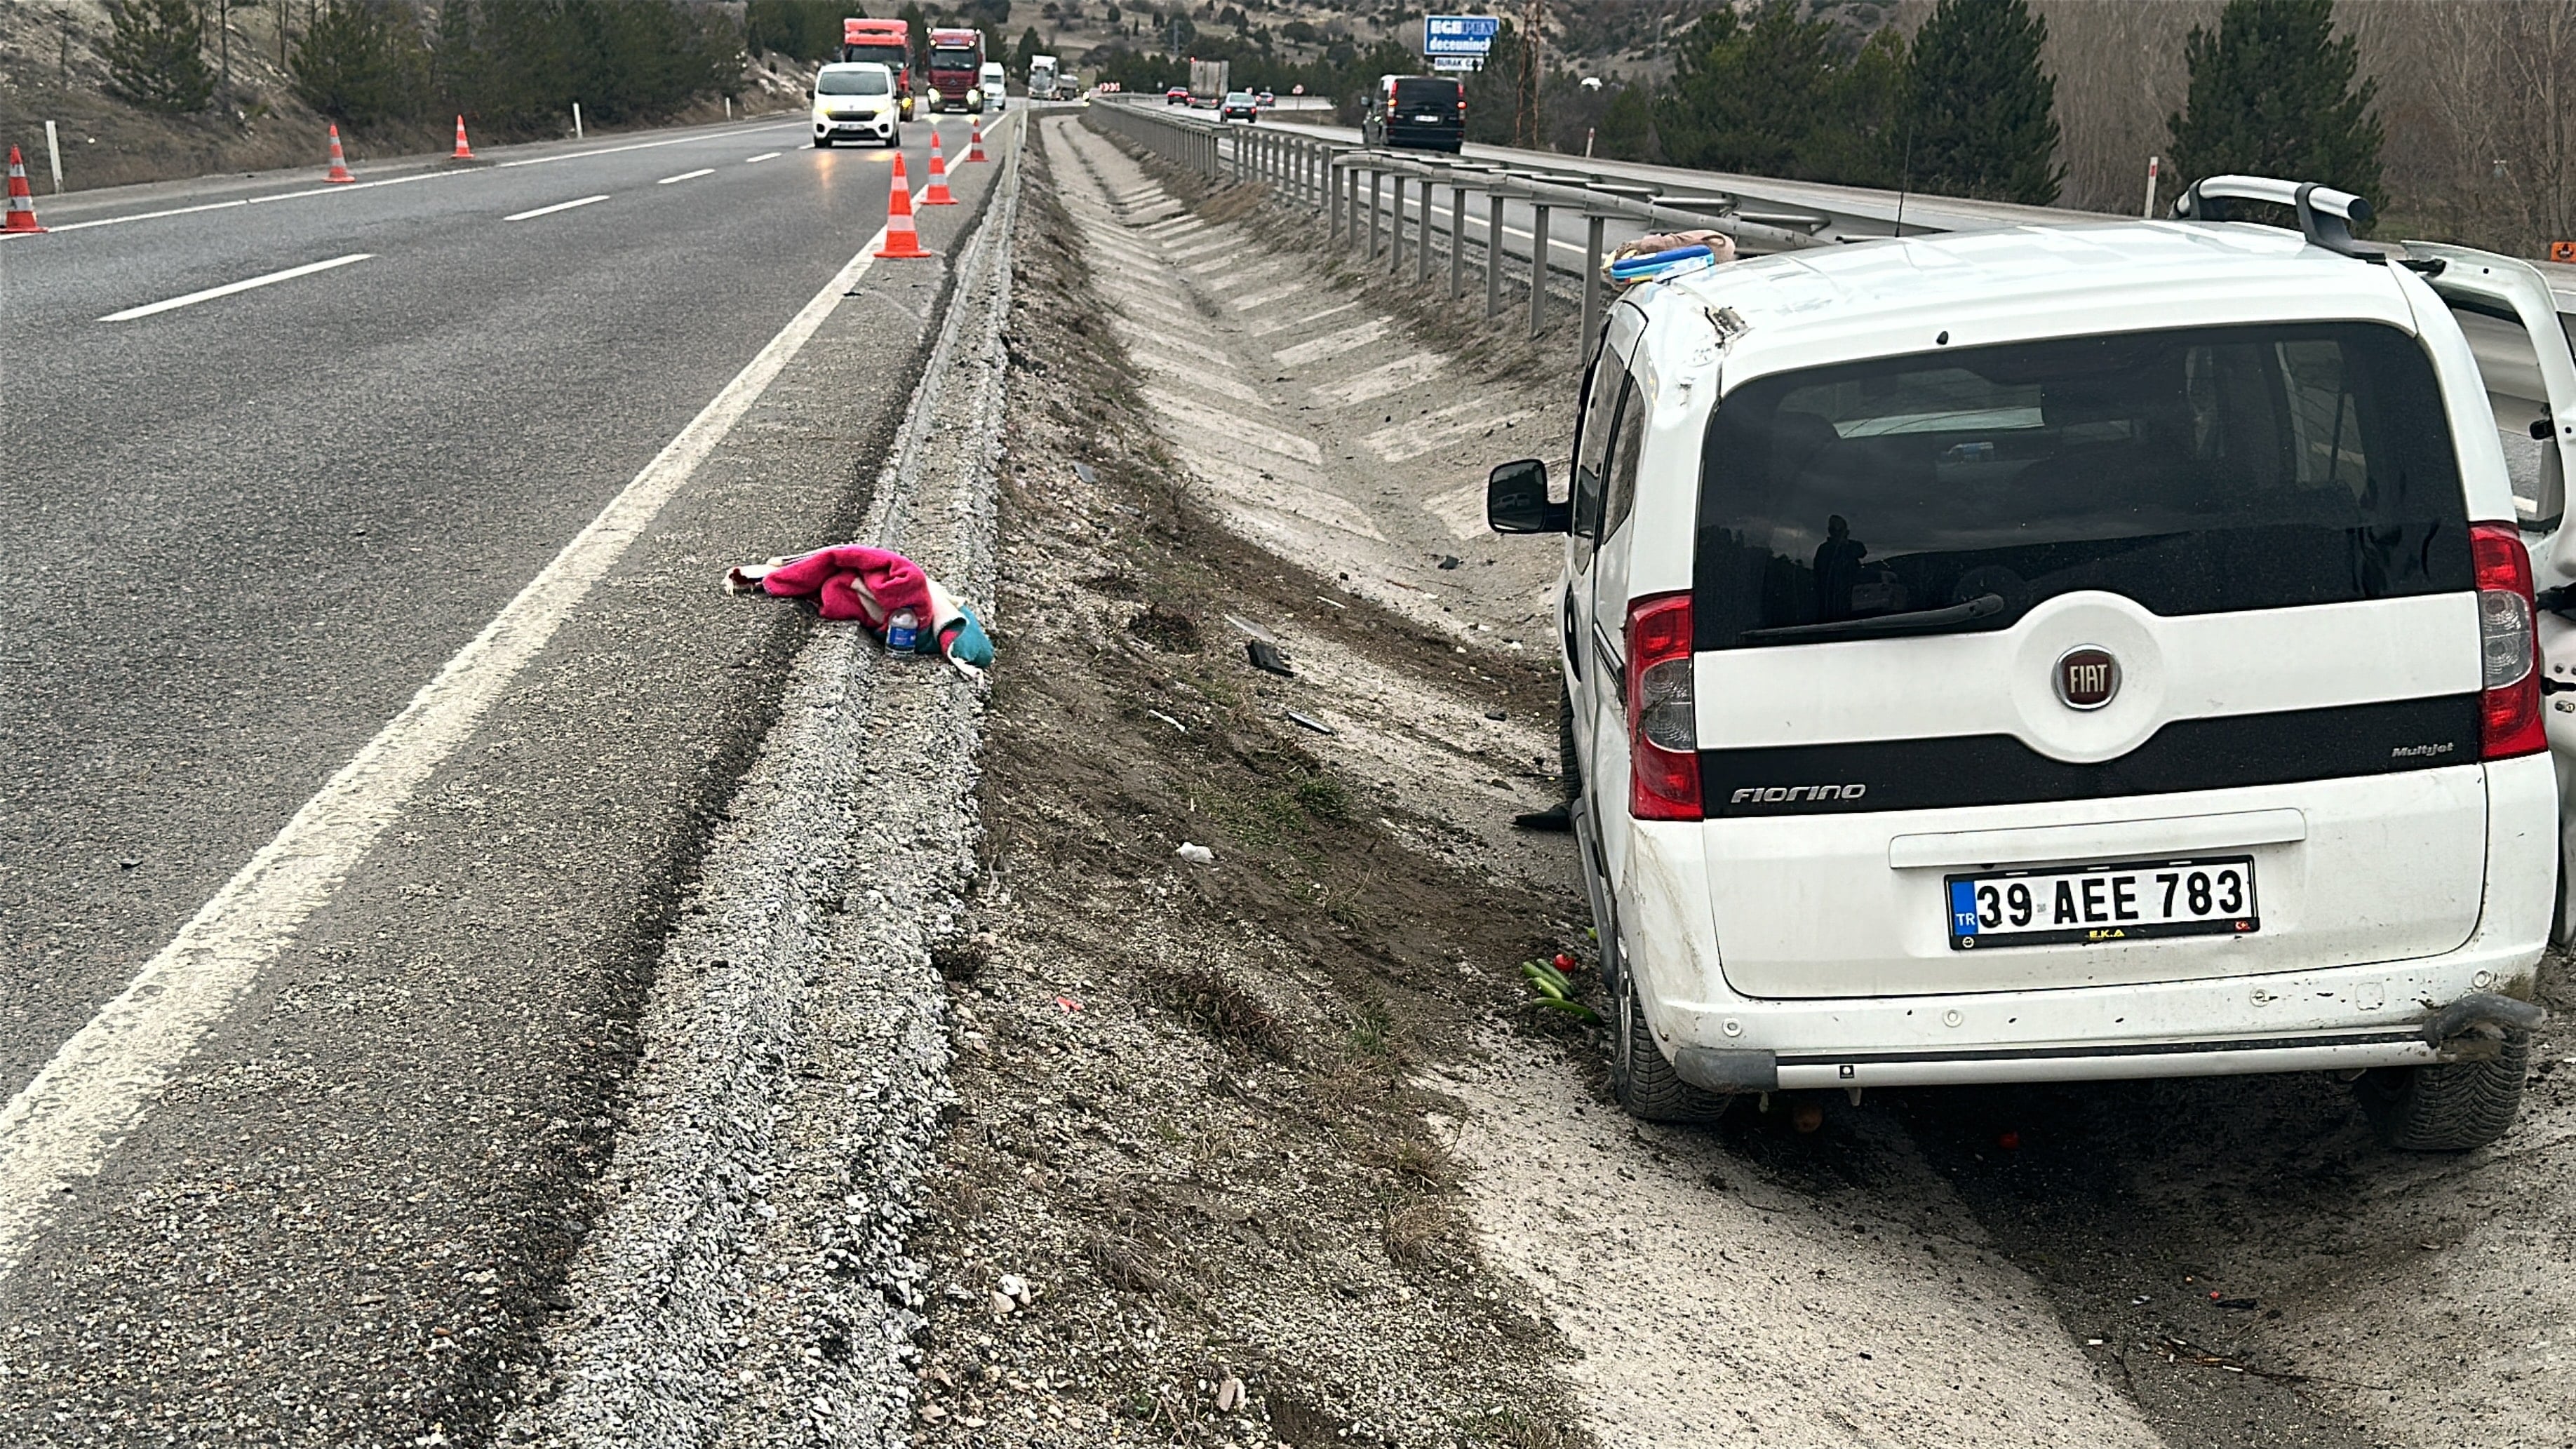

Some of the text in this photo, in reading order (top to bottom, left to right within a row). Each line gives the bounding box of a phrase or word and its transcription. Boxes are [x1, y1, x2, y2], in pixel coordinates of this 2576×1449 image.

[2069, 664, 2107, 693] FIAT
[1977, 870, 2243, 928] 39 AEE 783
[1955, 912, 1975, 926] TR
